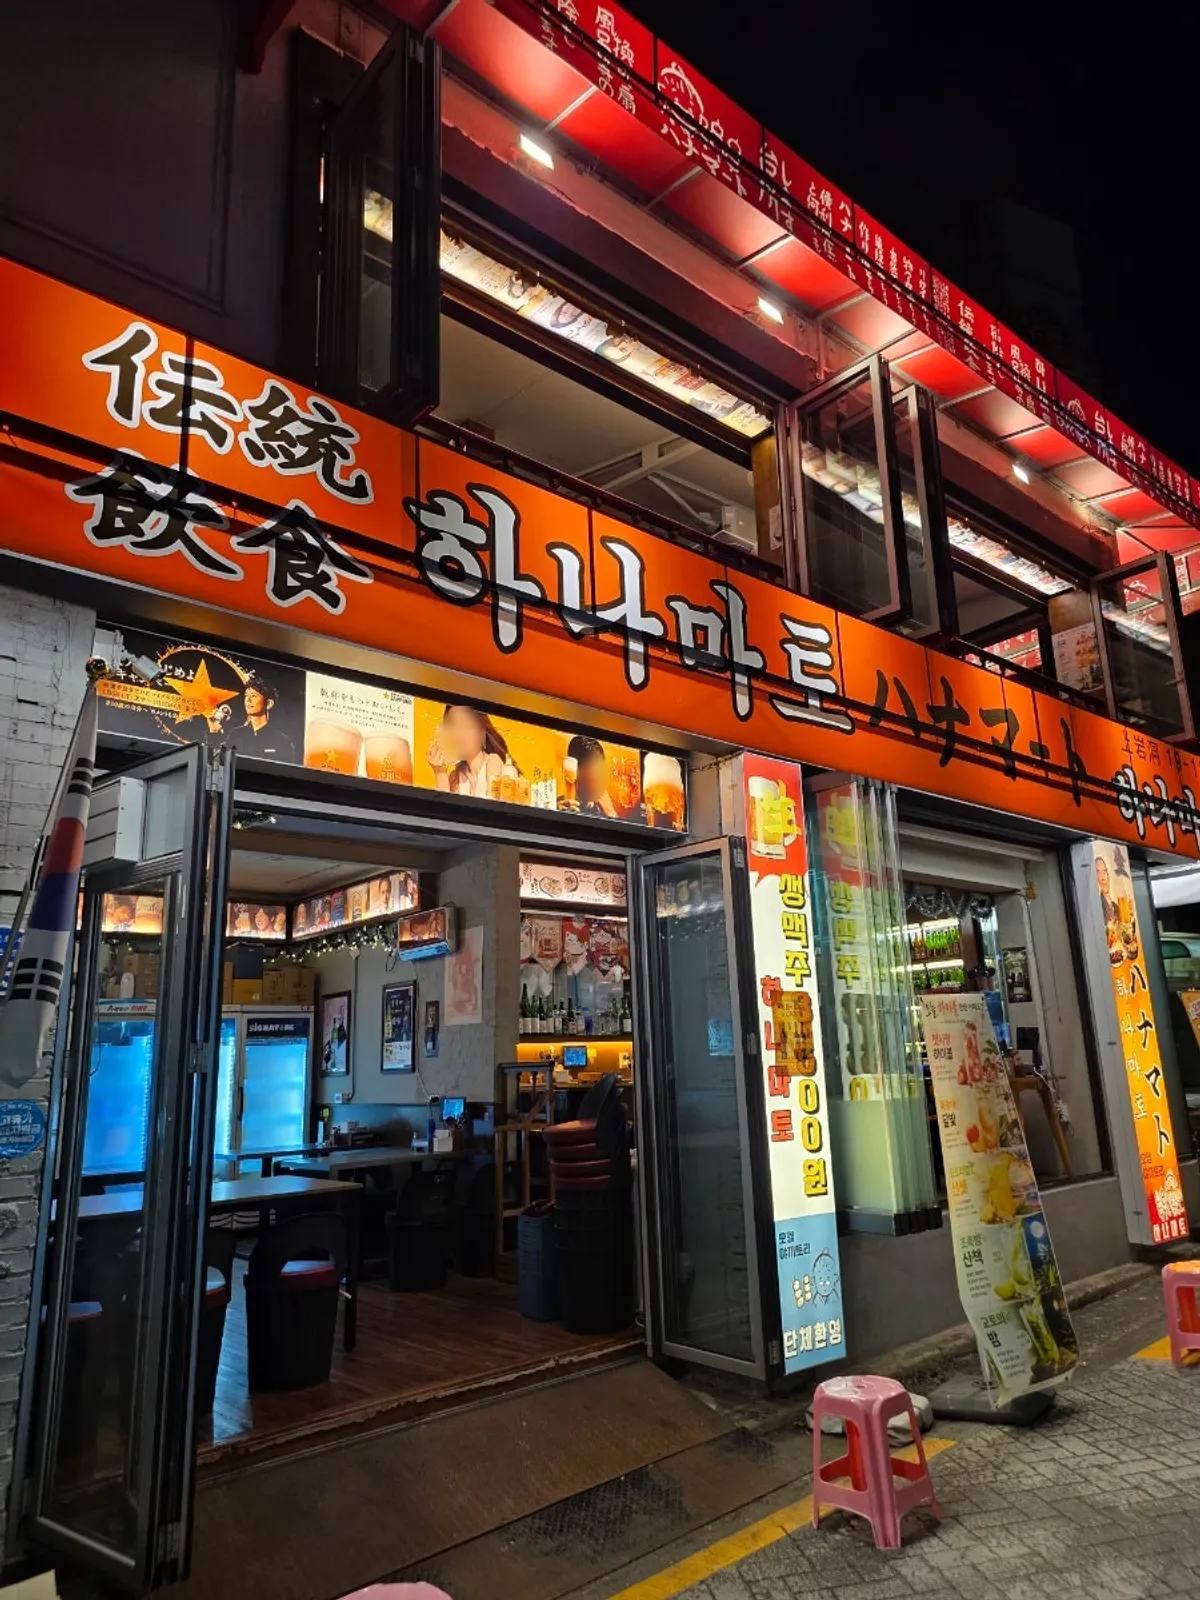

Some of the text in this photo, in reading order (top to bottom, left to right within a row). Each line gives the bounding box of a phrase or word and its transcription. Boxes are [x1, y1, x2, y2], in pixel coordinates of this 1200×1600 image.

[82, 322, 374, 504] 伝統
[65, 447, 374, 615] 飲食
[402, 482, 856, 734] 하나마토
[868, 669, 1090, 808] ハナマート
[779, 873, 811, 988] 생맥주
[963, 1248, 985, 1269] 산책
[783, 1318, 843, 1360] 단체환영
[986, 1329, 1002, 1348] 밤
